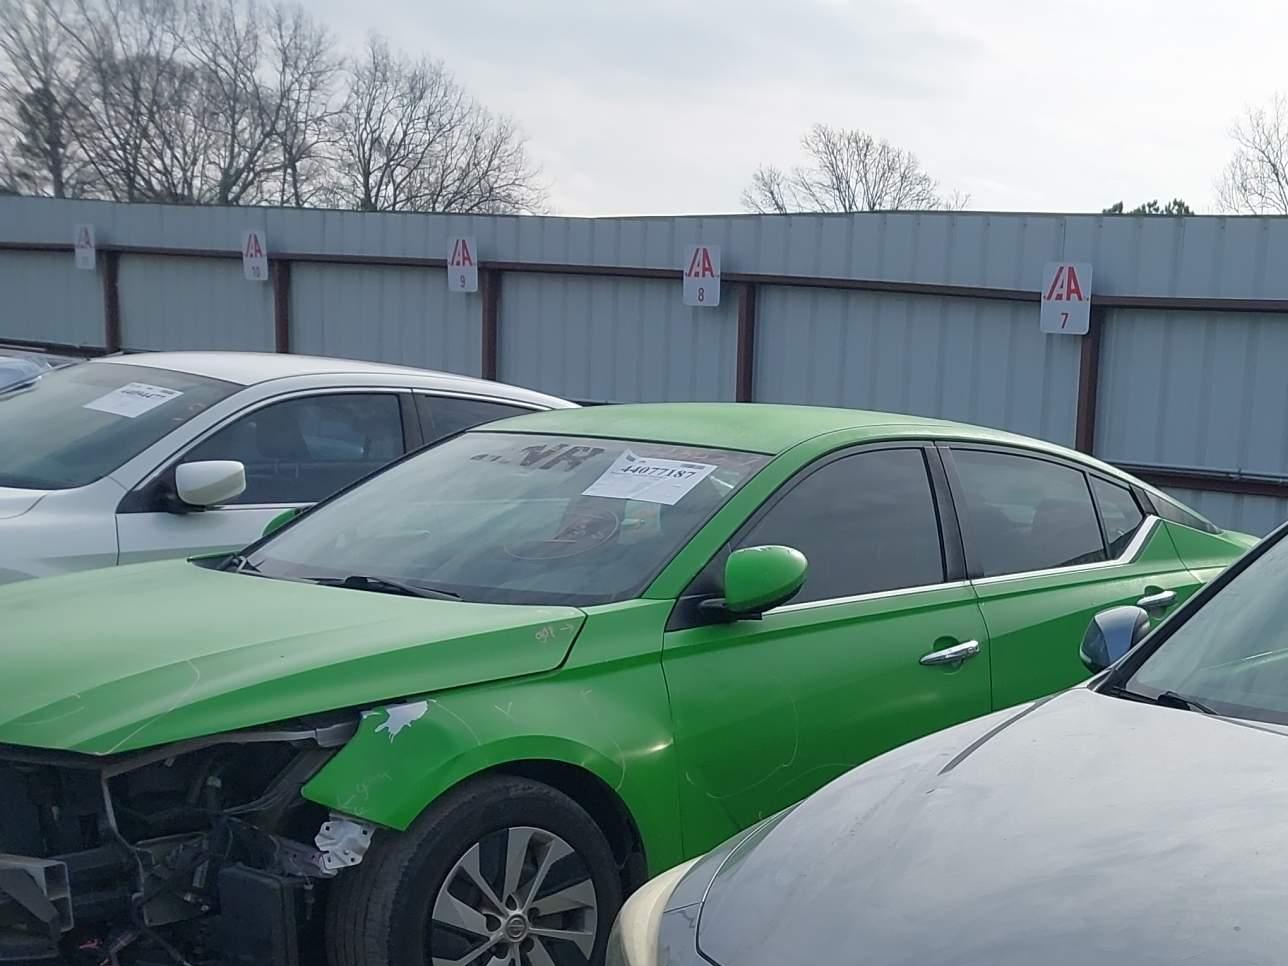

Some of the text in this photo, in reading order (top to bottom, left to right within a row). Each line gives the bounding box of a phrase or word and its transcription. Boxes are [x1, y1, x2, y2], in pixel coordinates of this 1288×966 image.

[460, 275, 466, 288] 9
[698, 288, 705, 302] 8
[1060, 312, 1069, 329] 7
[621, 465, 698, 480] 44077187
